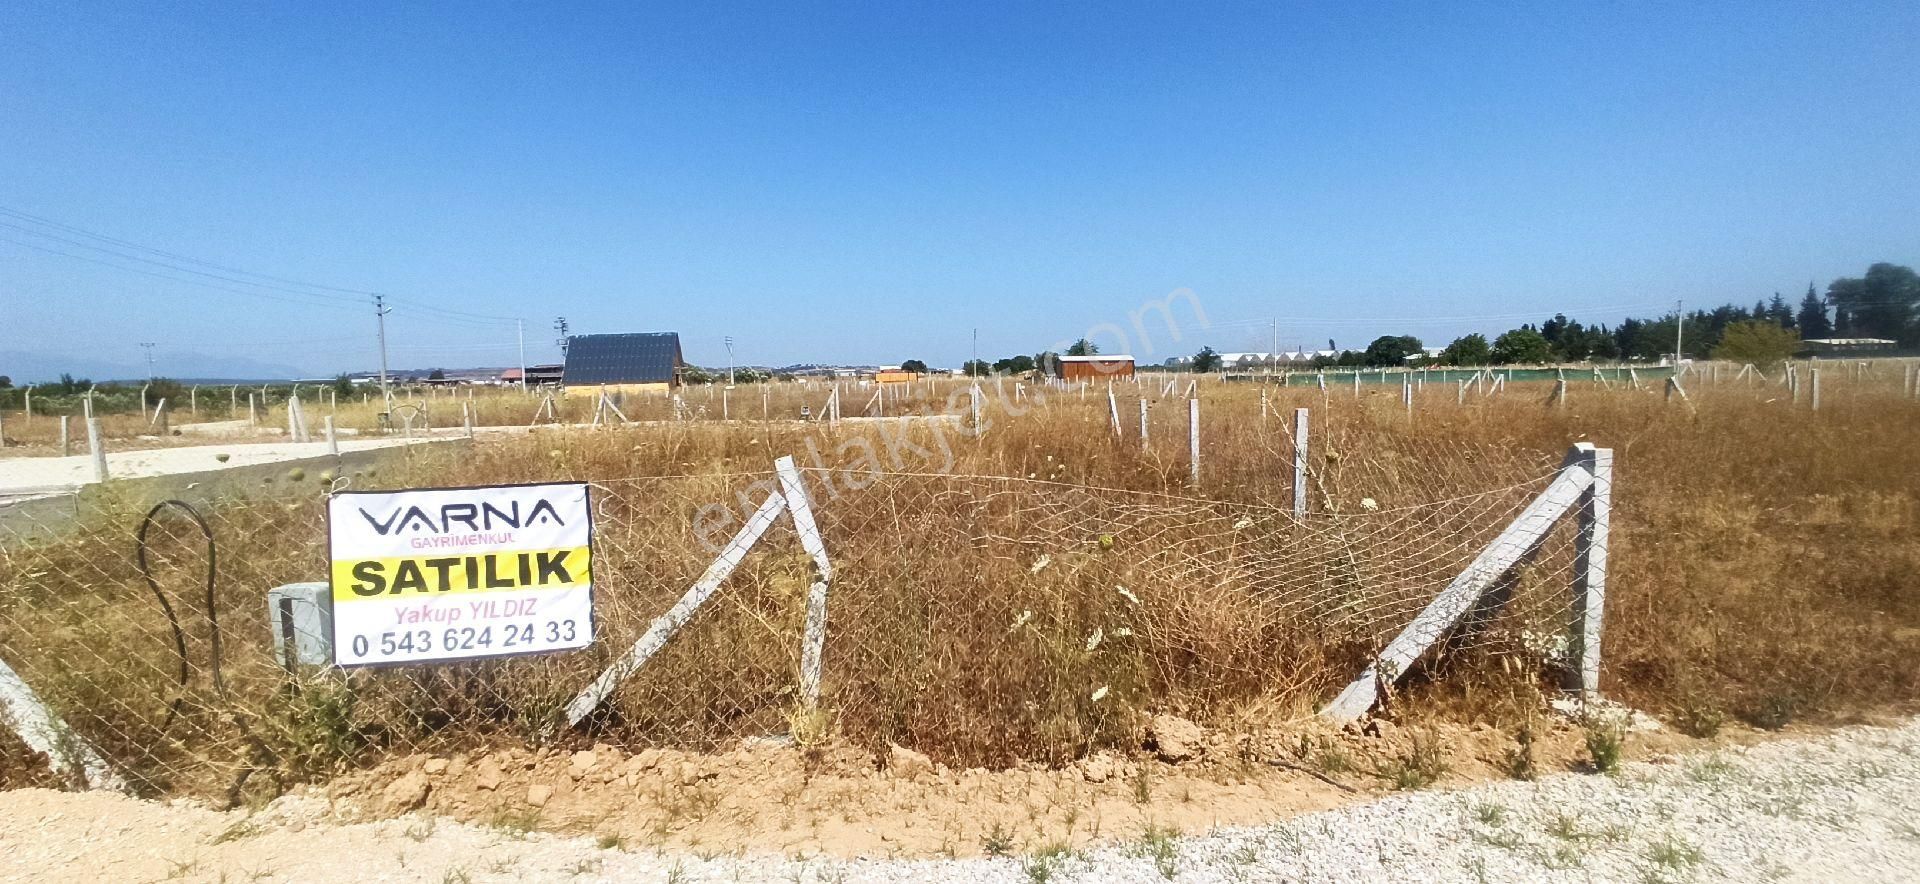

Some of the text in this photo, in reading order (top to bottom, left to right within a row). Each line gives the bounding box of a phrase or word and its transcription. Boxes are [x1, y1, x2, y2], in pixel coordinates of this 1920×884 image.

[358, 499, 565, 535] VARNA
[351, 550, 574, 597] SATILIK
[395, 597, 538, 625] Yakup YILDIZ
[352, 619, 577, 657] 0 543 624 24 33
